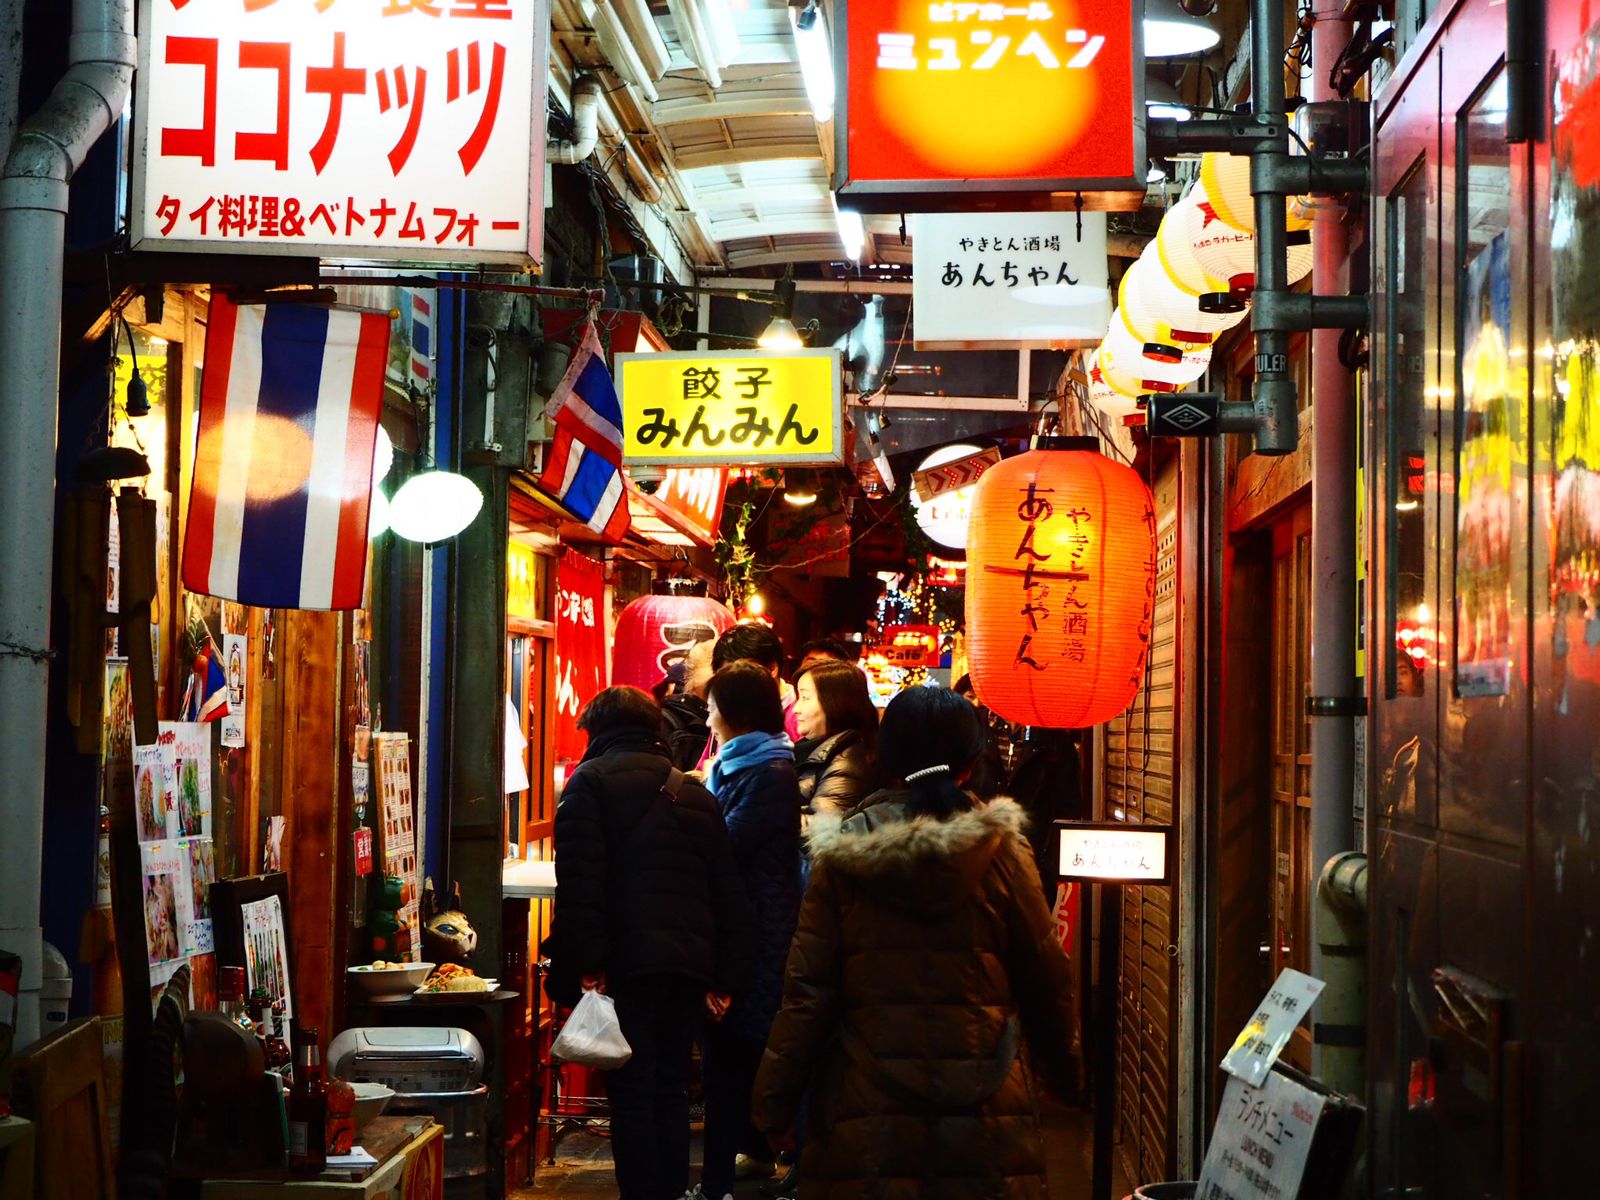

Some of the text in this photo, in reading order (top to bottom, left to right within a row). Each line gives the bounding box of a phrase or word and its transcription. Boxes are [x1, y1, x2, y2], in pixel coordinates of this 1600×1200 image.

[928, 1, 1055, 22] ビアホール
[876, 30, 1106, 70] ミュンヘン
[160, 31, 507, 178] ココナッツ
[155, 193, 520, 247] タイ料理&ベトナムフォー
[958, 235, 1061, 252] やきとん酒場
[940, 261, 1079, 287] あんちゃん
[682, 366, 772, 400] 餃子
[636, 403, 819, 448] みんみん
[1013, 482, 1056, 672] あんちゃん
